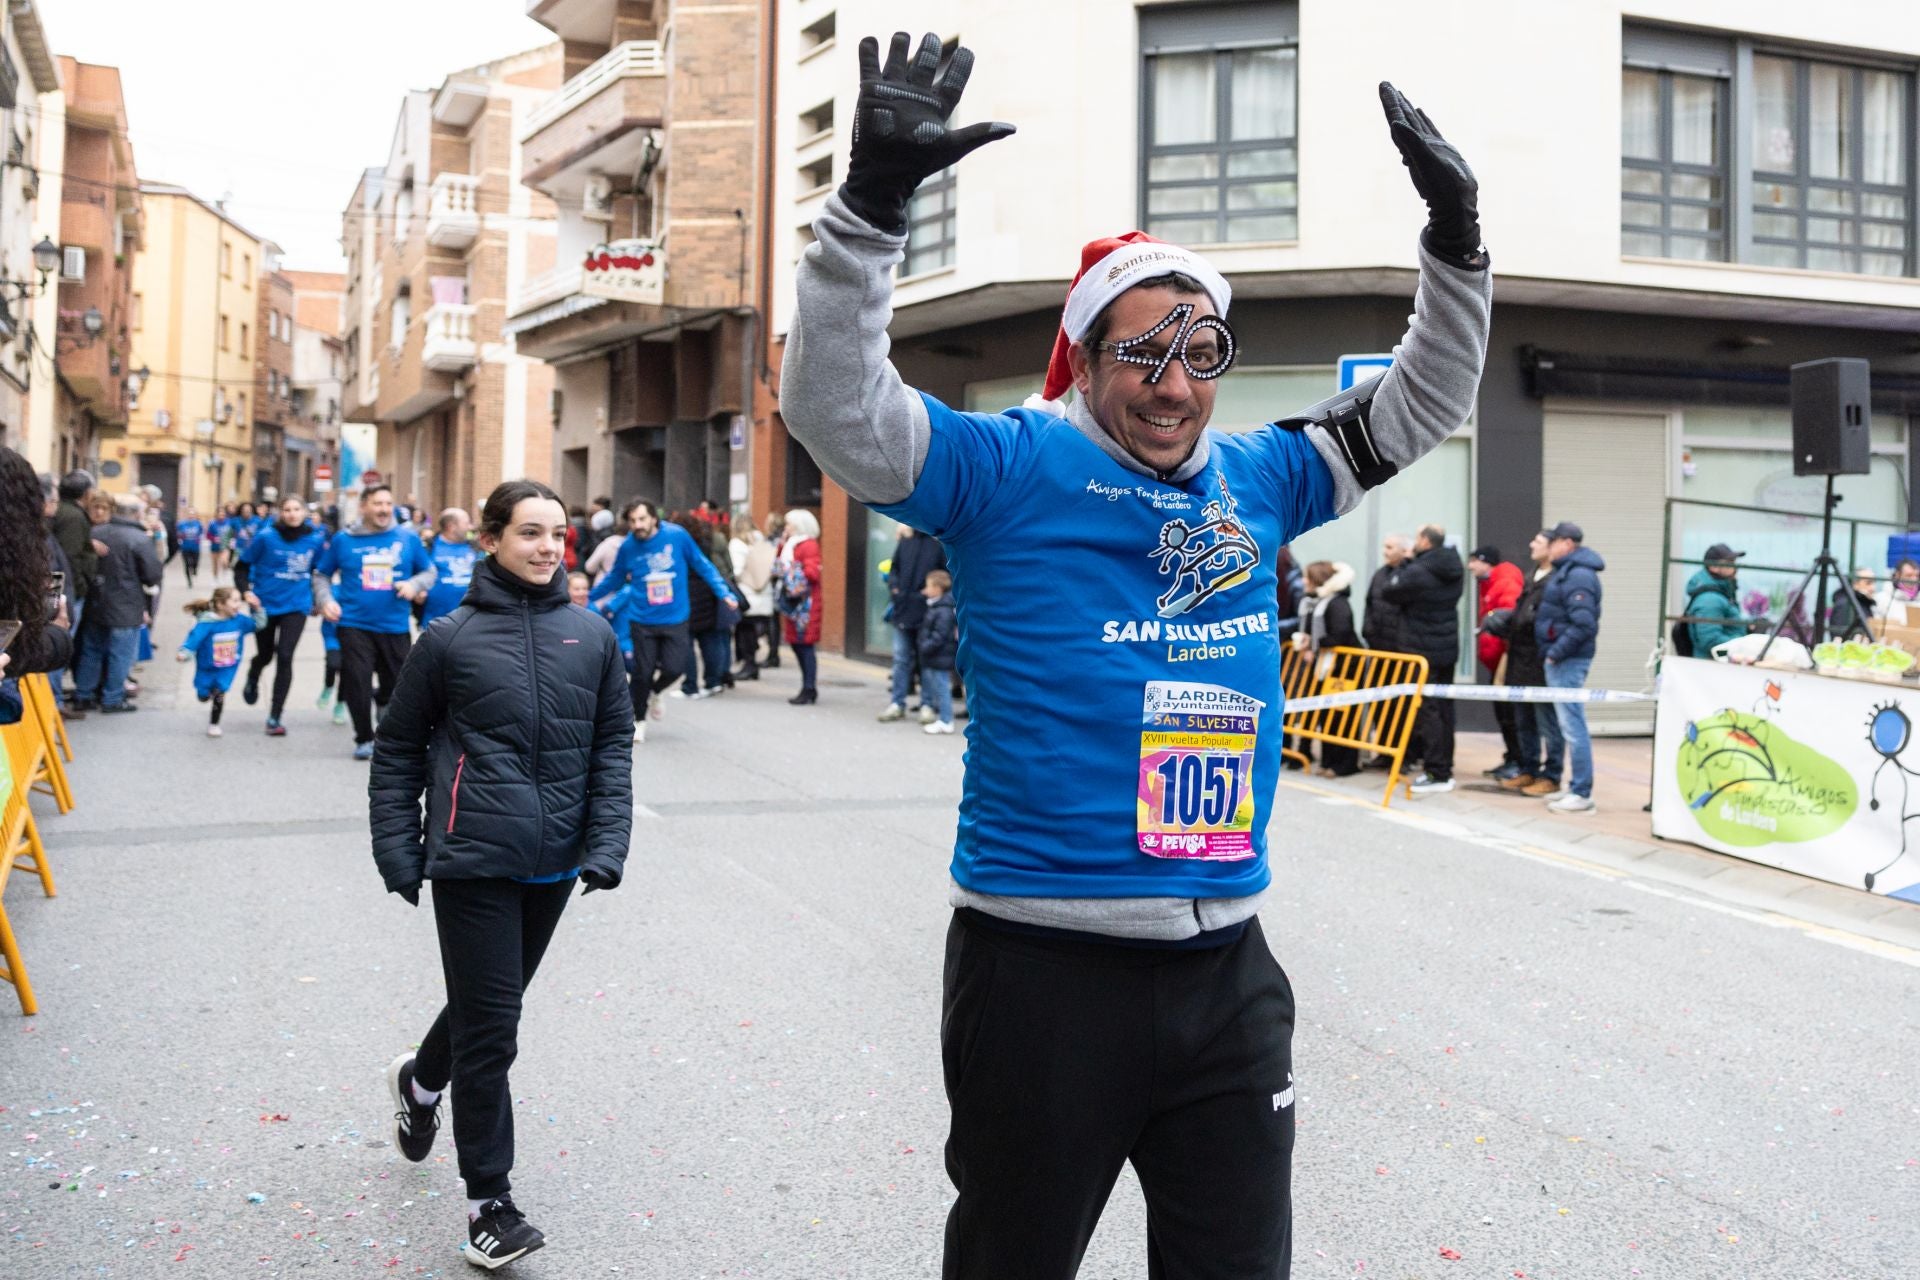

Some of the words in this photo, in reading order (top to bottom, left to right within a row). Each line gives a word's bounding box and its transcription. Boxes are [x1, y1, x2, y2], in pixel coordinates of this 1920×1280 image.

[1086, 478, 1132, 501] Amigos
[1153, 500, 1162, 509] de
[1101, 620, 1160, 643] SAN
[1165, 612, 1270, 642] SILVESTRE
[1167, 643, 1237, 663] Lardero
[1167, 689, 1255, 704] LARDERO
[1162, 701, 1256, 713] ayuntamiento
[1153, 713, 1180, 727] SAN
[1187, 715, 1251, 731] SILVESTRE
[1143, 733, 1168, 744] XVIII
[1170, 734, 1199, 745] vuelta
[1201, 735, 1232, 747] Popular
[1157, 754, 1241, 827] 1057
[1777, 765, 1848, 815] Amigos
[1161, 834, 1207, 854] PEVISA
[1272, 1084, 1295, 1112] PUM
